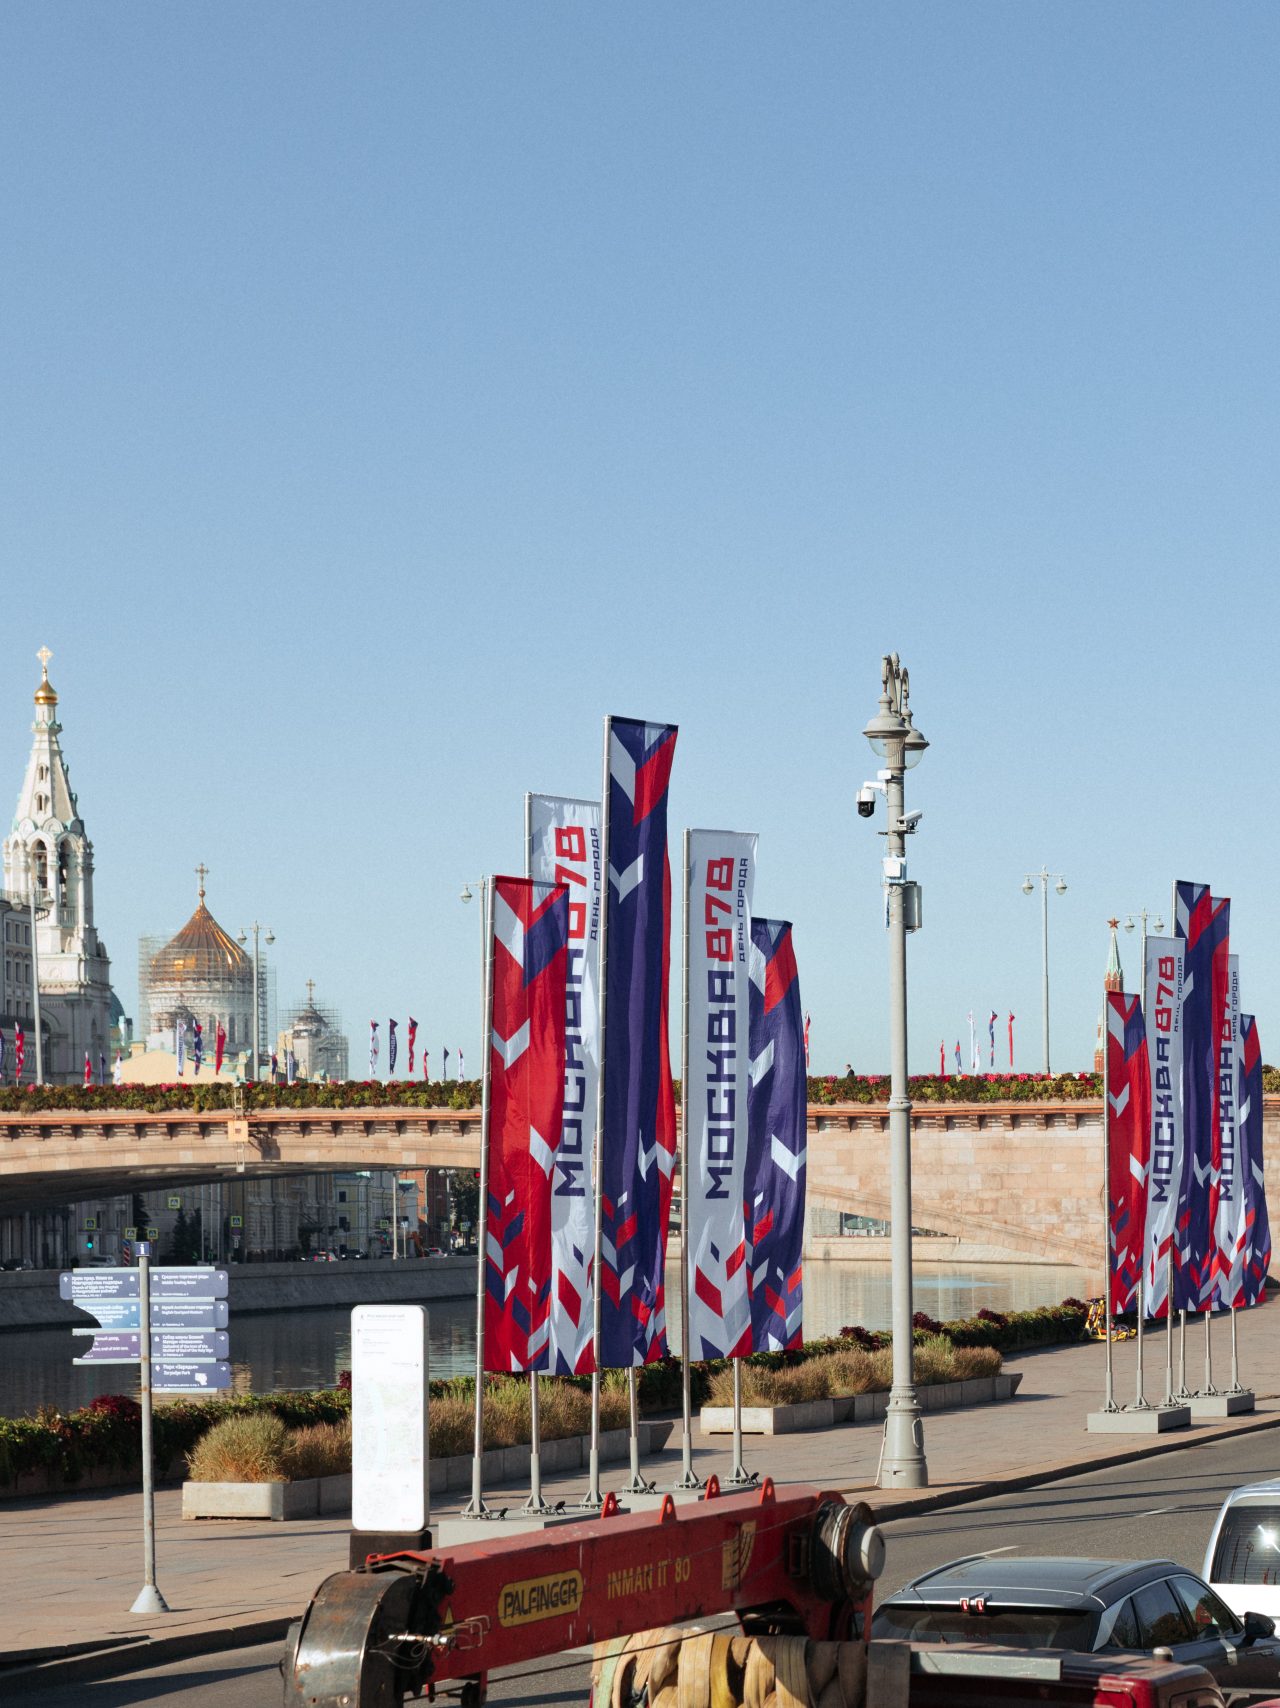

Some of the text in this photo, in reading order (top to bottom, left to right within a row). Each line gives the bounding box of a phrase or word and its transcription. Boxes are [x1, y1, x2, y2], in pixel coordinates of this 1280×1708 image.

[590, 827, 601, 941] ДЕНЬ ГОРОДА
[737, 857, 749, 962] ДЕНЬ ГОРОДА
[704, 857, 737, 1199] МОСКВА 878
[1232, 971, 1240, 1012] ГОРОДА
[1152, 956, 1175, 1202] МОСКВА 878
[503, 1577, 578, 1619] PALFINGER
[607, 1563, 653, 1600] INMAN
[674, 1556, 691, 1583] 80
